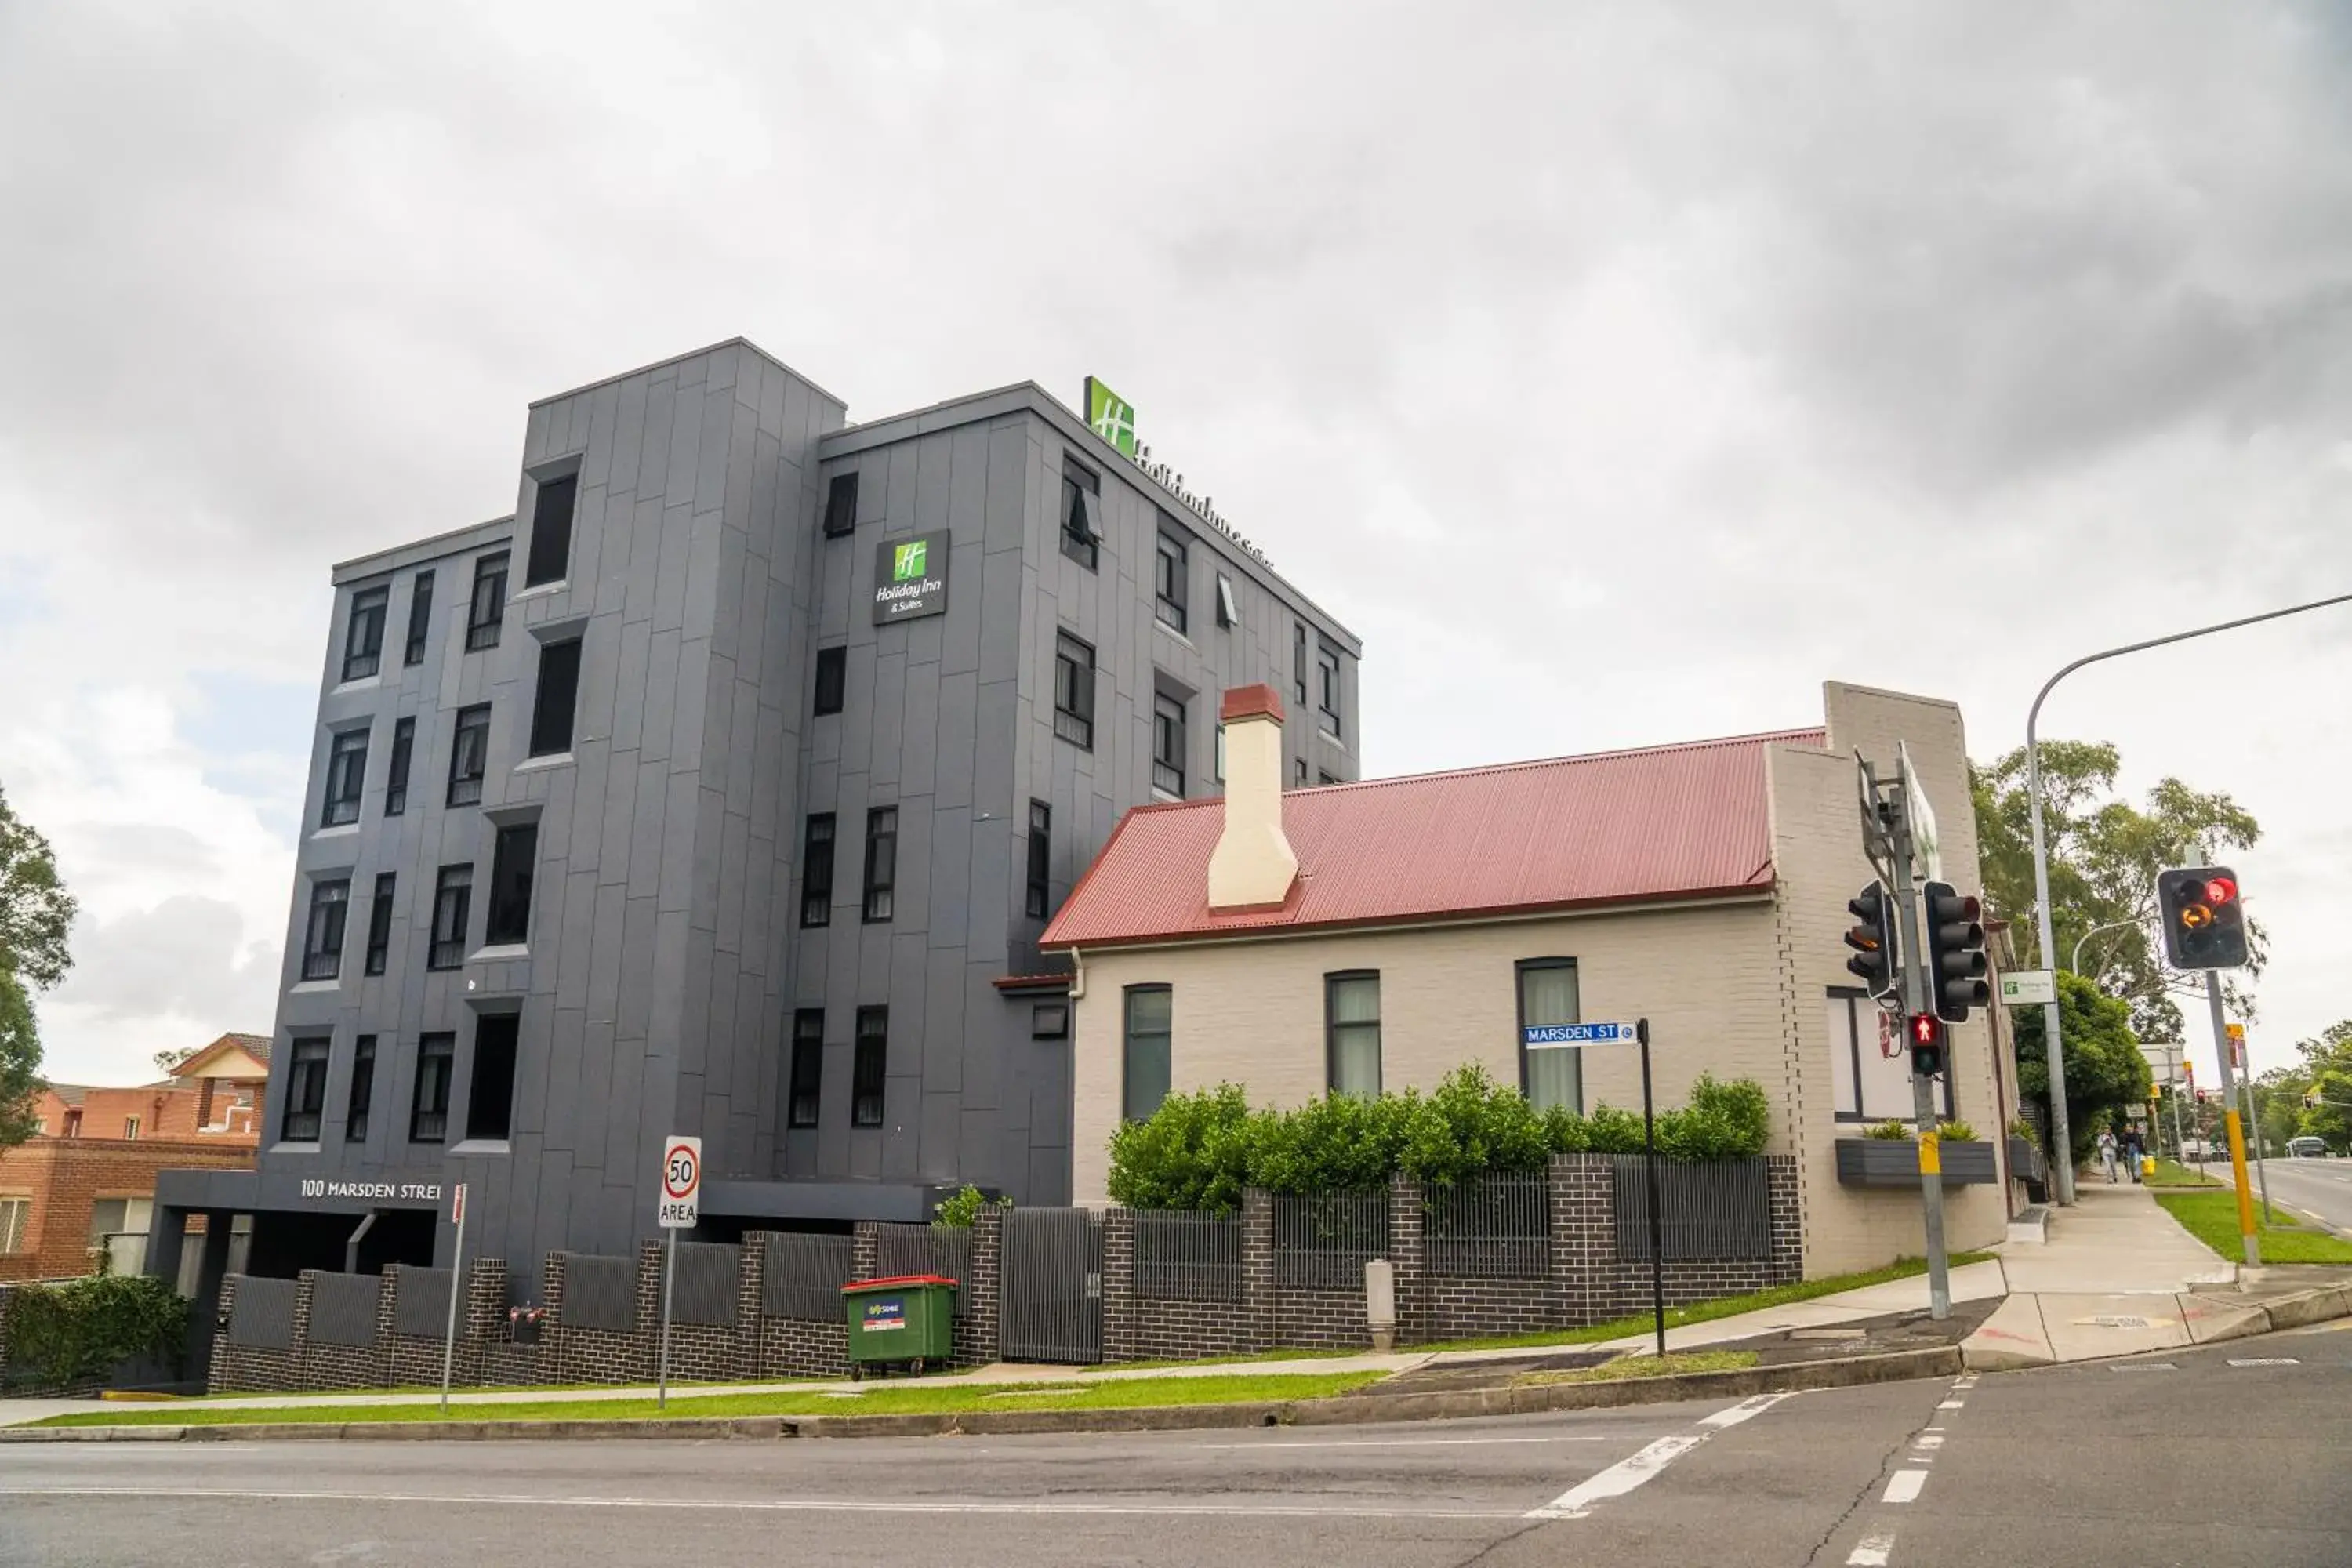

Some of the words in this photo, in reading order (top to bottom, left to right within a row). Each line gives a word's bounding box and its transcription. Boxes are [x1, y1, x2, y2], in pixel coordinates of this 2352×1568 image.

[876, 583, 920, 602] Holiday
[922, 579, 941, 593] Inn
[891, 603, 898, 613] &
[898, 599, 923, 612] Suites
[1529, 1026, 1592, 1041] MARSDEN
[1599, 1025, 1615, 1037] ST
[669, 1160, 692, 1182] 50
[301, 1180, 324, 1197] 100
[327, 1182, 394, 1198] MARSDEN
[661, 1204, 695, 1221] AREA
